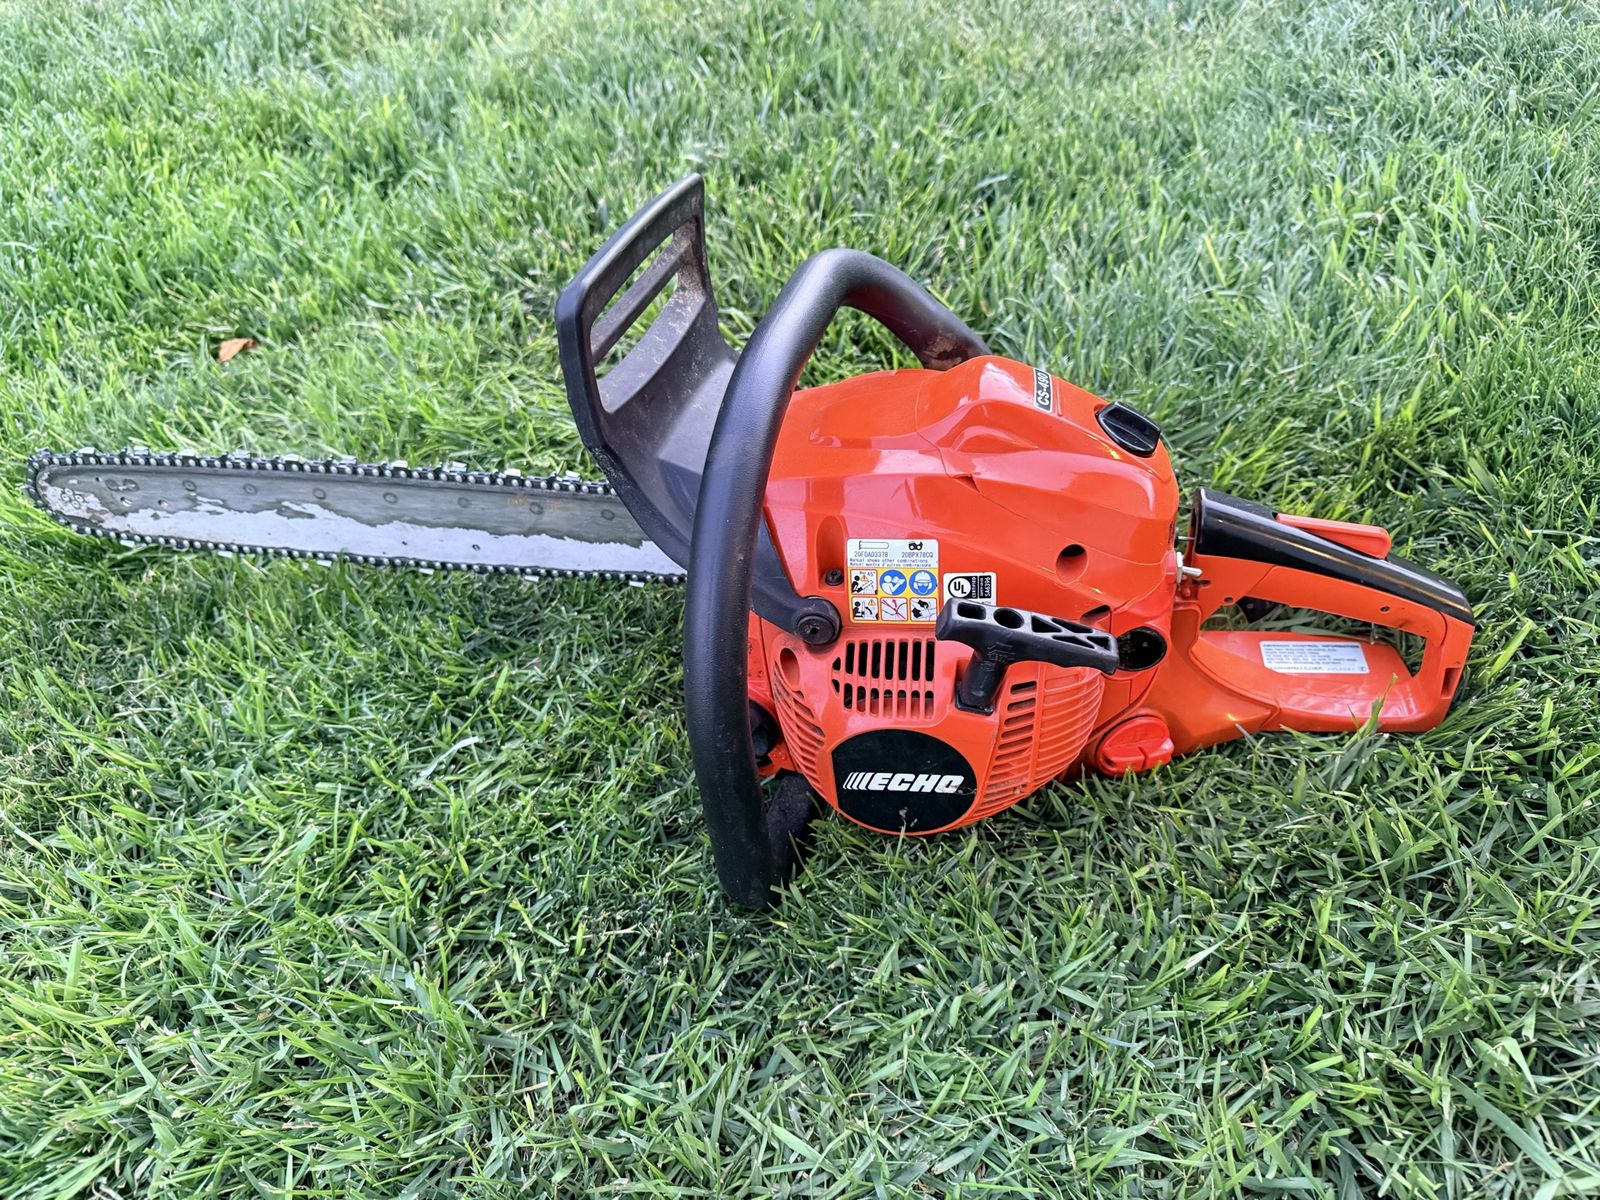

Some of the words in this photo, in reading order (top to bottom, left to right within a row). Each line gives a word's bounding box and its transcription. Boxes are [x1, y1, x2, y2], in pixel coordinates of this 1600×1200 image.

[1037, 372, 1050, 406] CS-490
[953, 581, 967, 594] UL
[867, 772, 965, 794] ECHO
